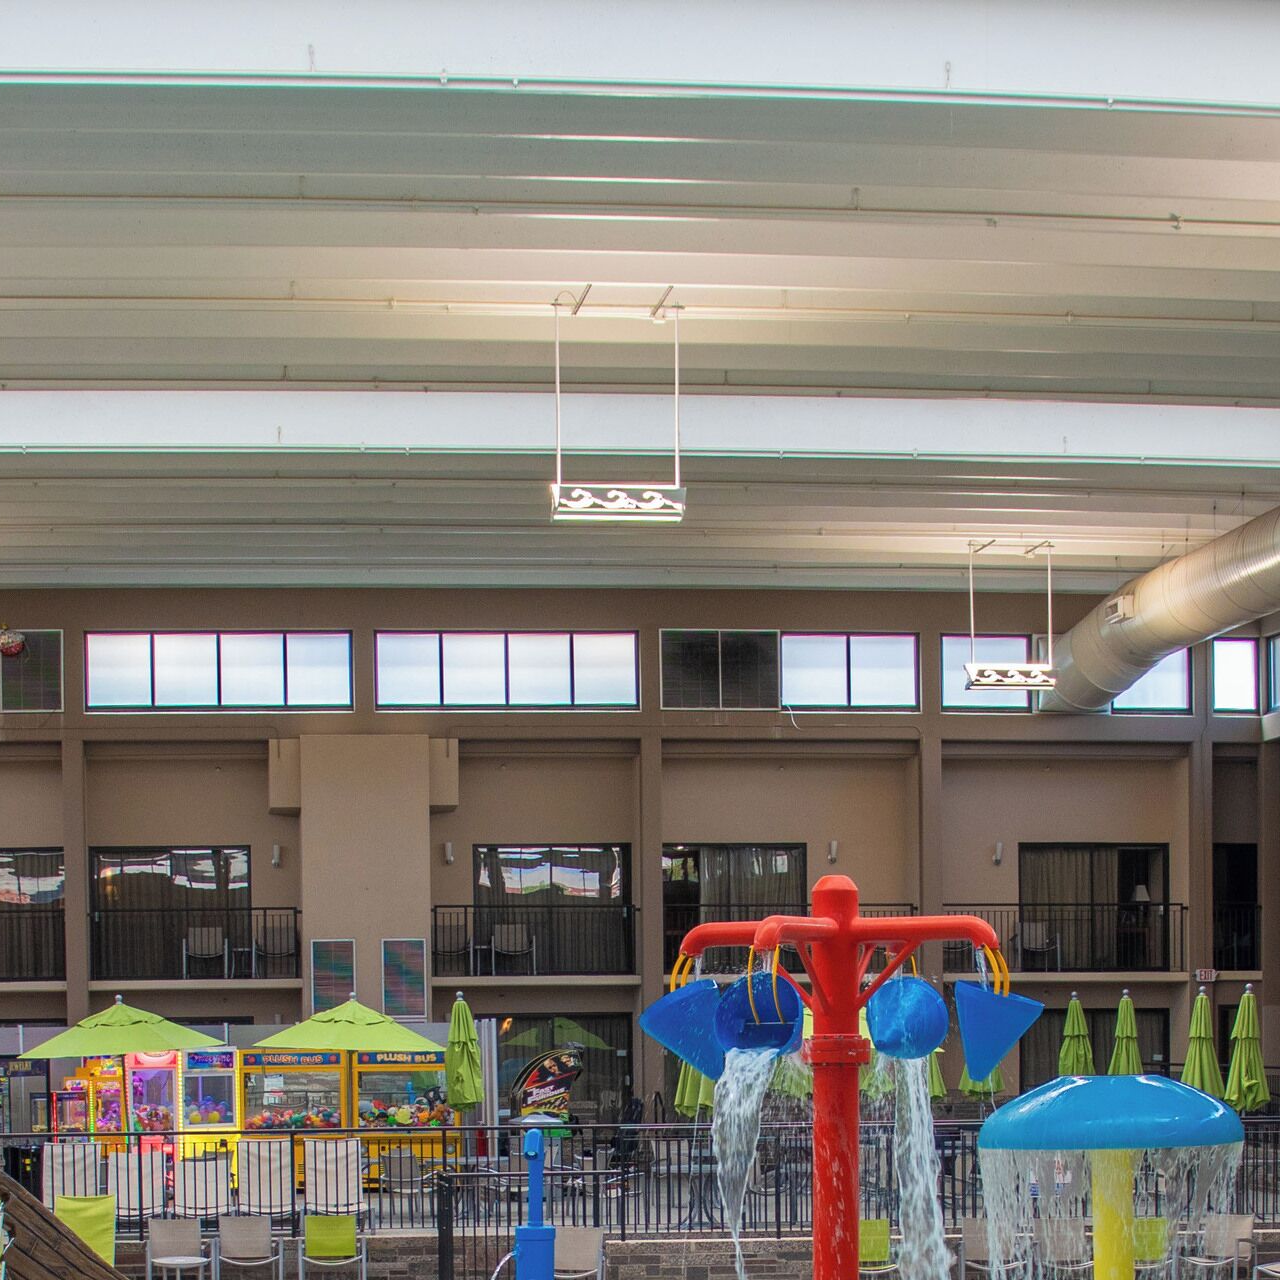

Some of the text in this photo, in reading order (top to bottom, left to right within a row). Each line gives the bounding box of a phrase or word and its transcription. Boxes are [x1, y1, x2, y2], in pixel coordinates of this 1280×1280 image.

[1200, 970, 1213, 980] EXIT
[262, 1055, 323, 1064] PLUSH BUS
[376, 1053, 436, 1063] PLUSH BUS
